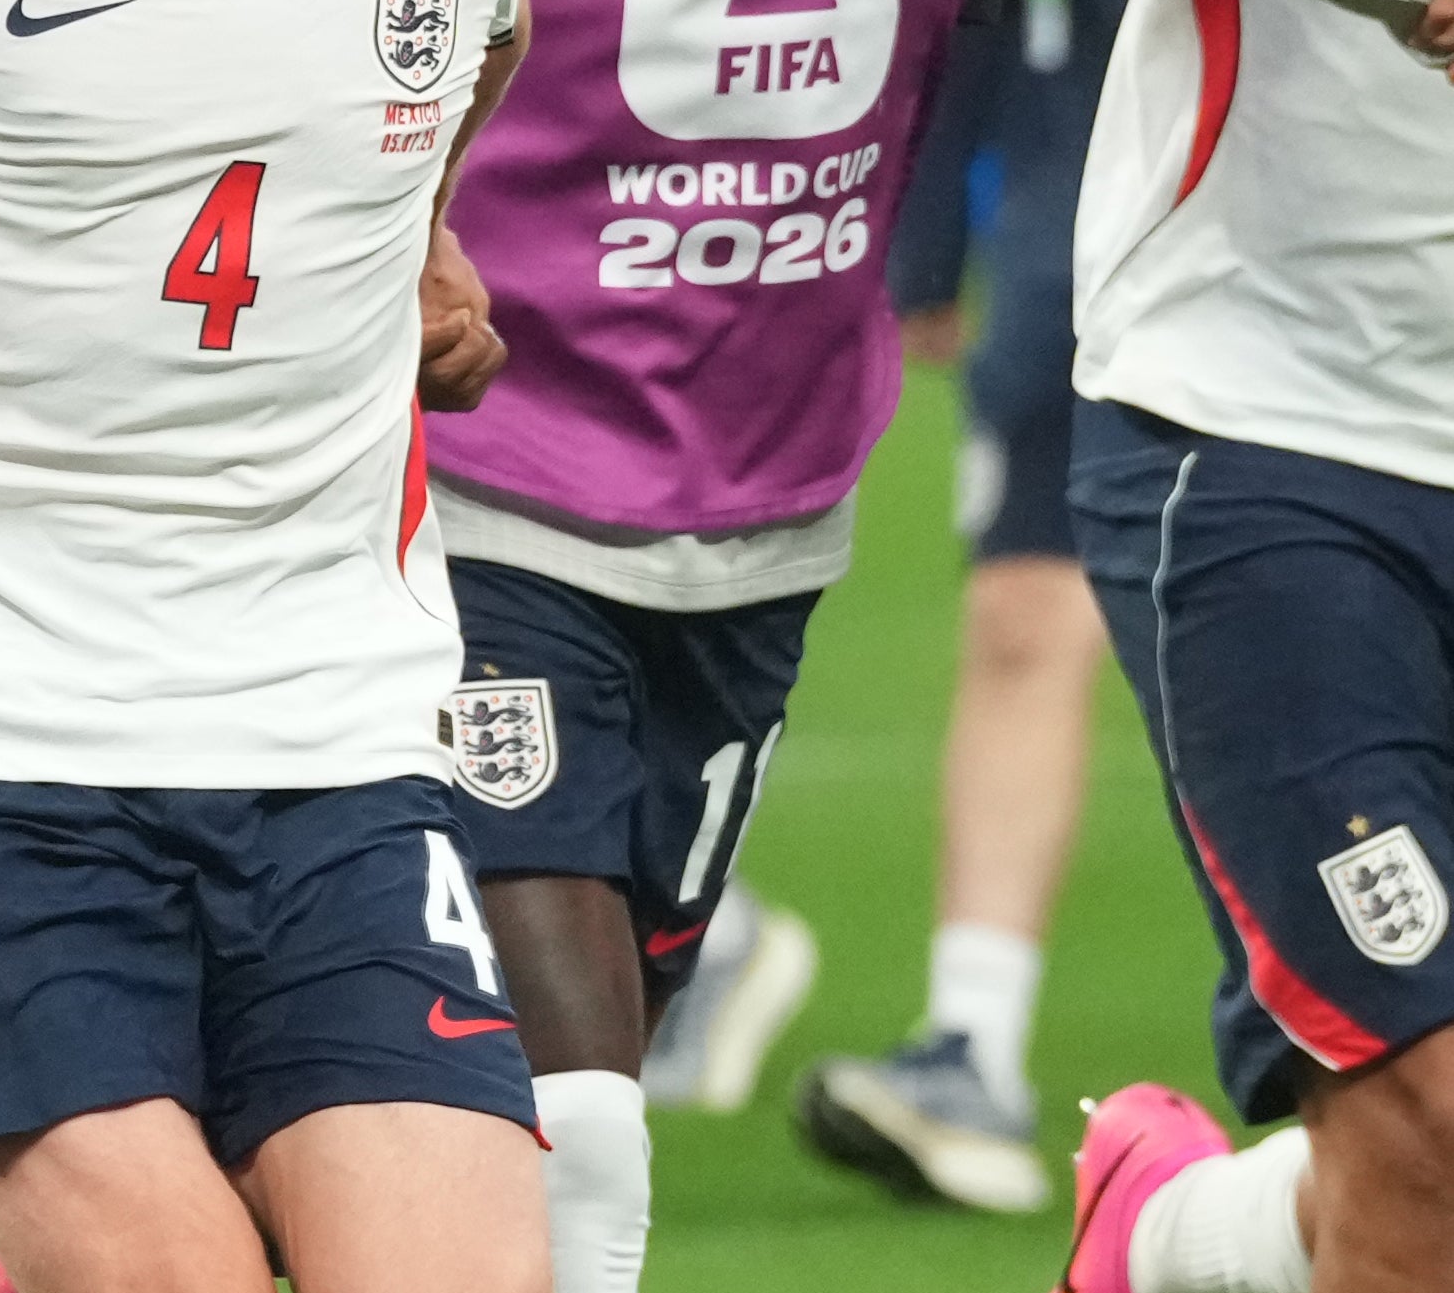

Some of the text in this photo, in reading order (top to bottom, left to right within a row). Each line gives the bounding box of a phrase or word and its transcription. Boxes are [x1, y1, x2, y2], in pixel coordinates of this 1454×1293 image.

[714, 37, 840, 96] FIFA
[384, 100, 442, 126] MEXICO
[606, 142, 881, 207] WORLD CUP
[161, 160, 267, 351] 4
[598, 198, 869, 289] 2026
[422, 829, 498, 995] 4
